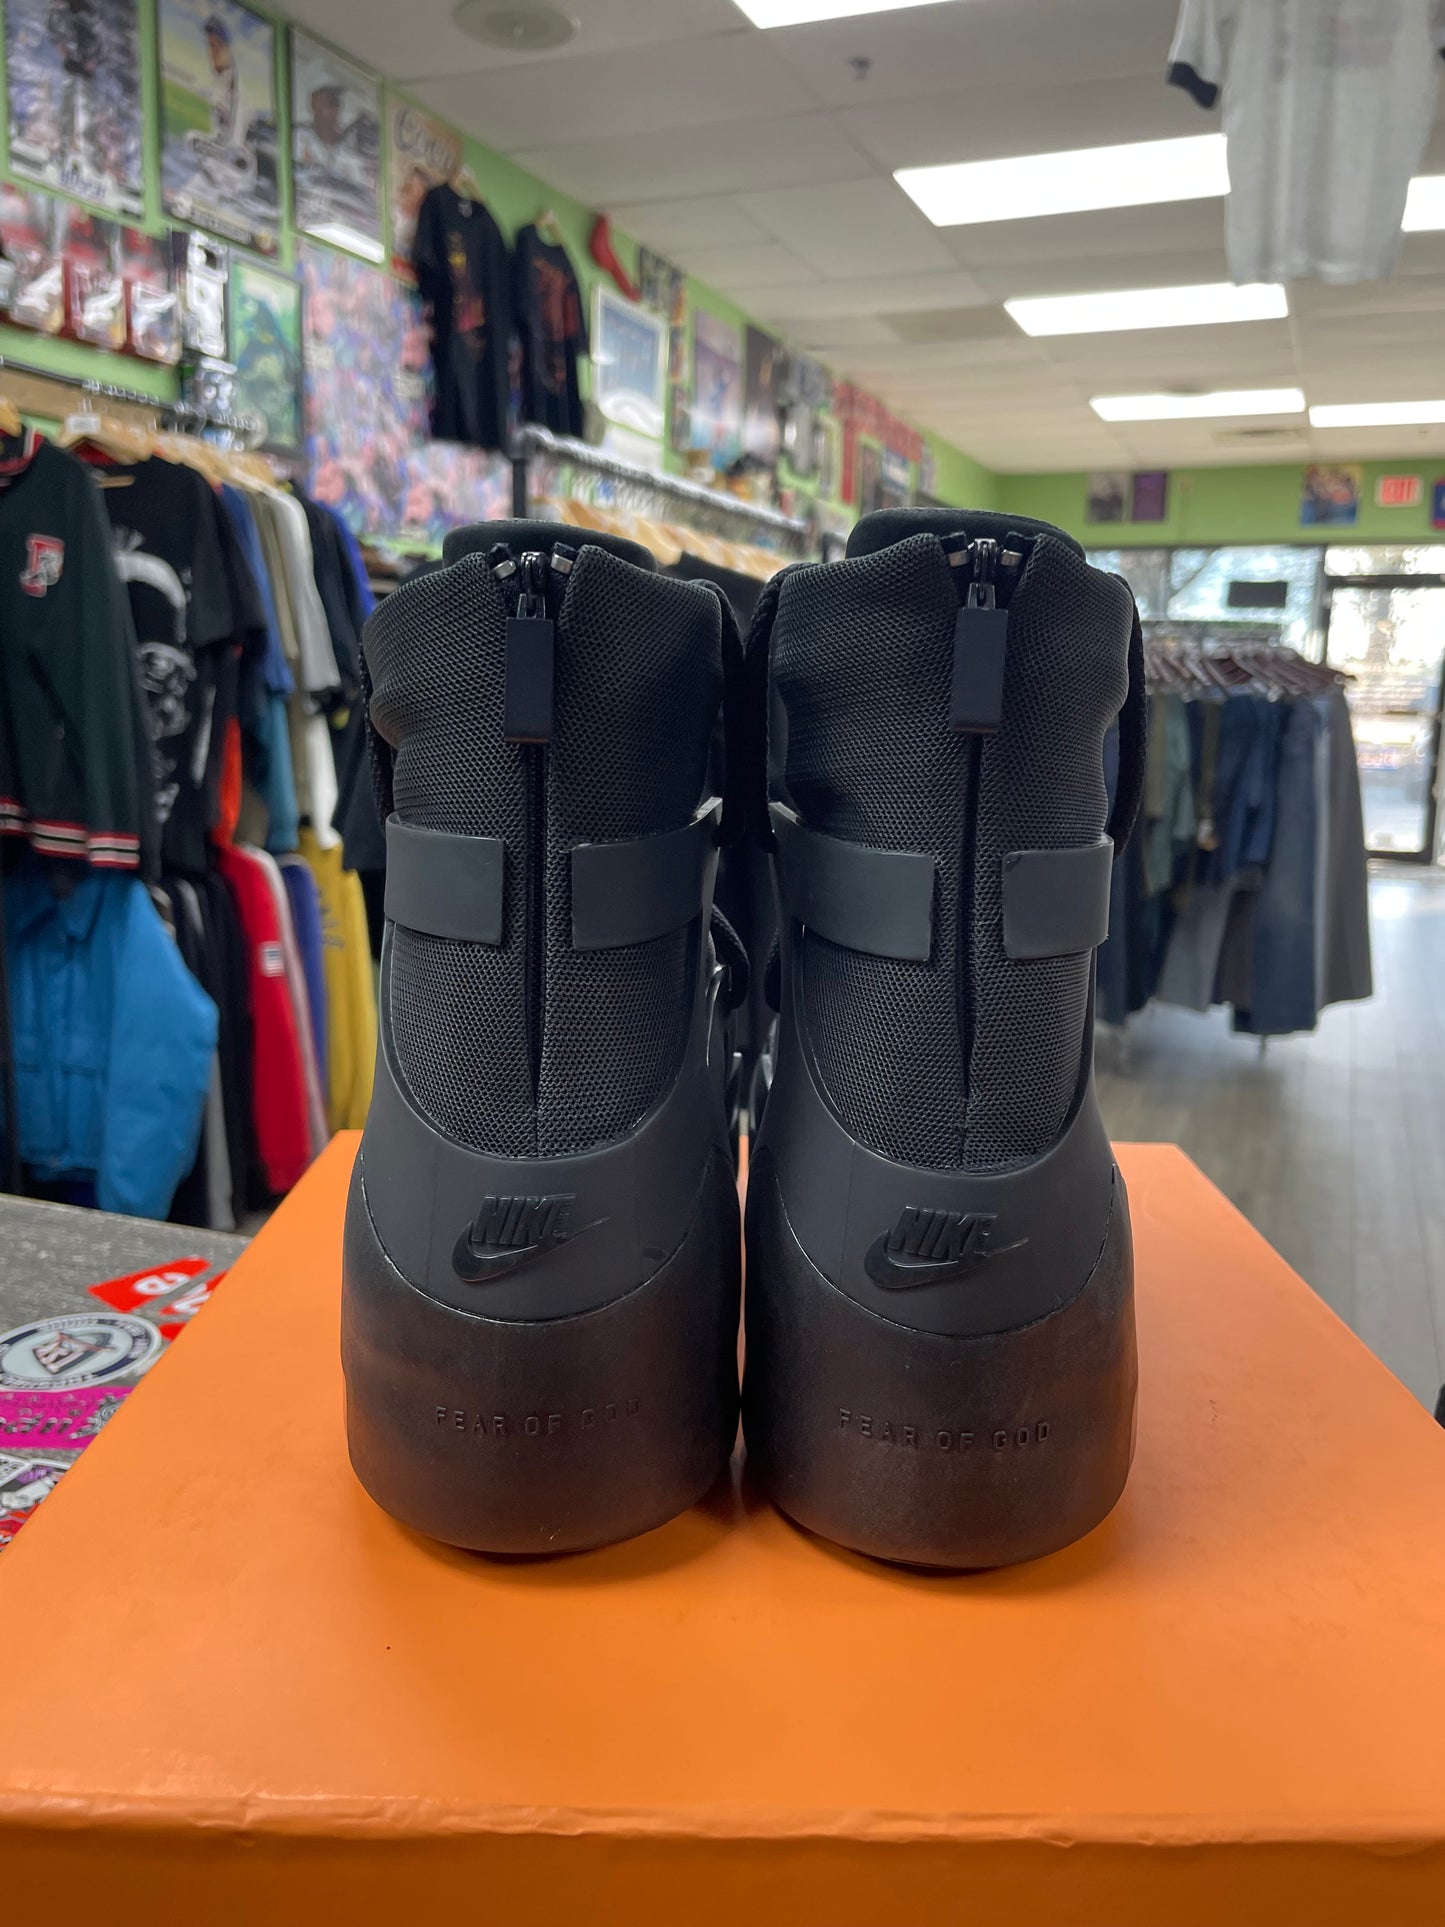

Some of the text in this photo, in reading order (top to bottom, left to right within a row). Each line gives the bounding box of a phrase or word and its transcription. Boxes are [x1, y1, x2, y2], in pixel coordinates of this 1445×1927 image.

[471, 1194, 576, 1245] NIKE
[888, 1205, 998, 1259] NIKE
[434, 1406, 507, 1436] FEAR
[525, 1414, 561, 1436] OF
[839, 1407, 1049, 1450] FEAR OF GOD
